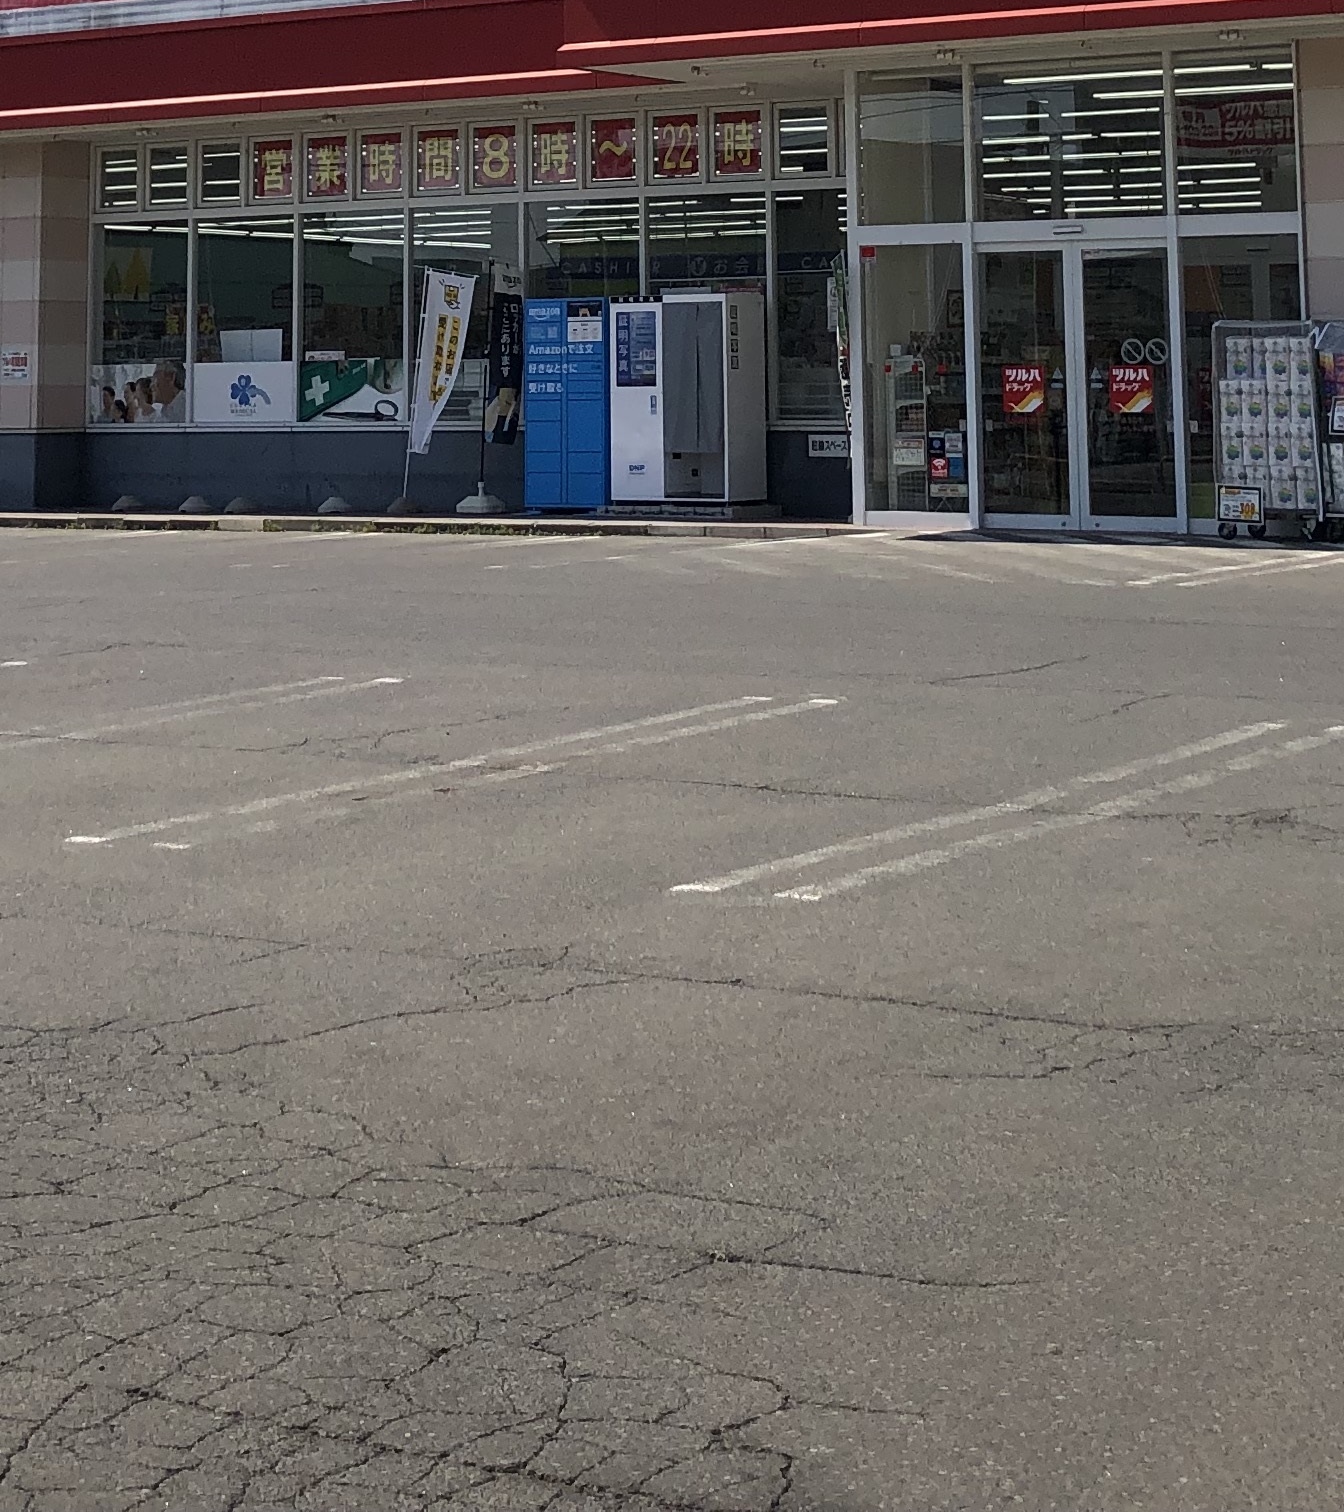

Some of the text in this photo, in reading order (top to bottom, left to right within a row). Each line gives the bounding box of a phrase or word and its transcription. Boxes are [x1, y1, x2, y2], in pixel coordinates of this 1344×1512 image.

[1005, 368, 1041, 382] ツルハ
[1112, 368, 1149, 382] ツルハ
